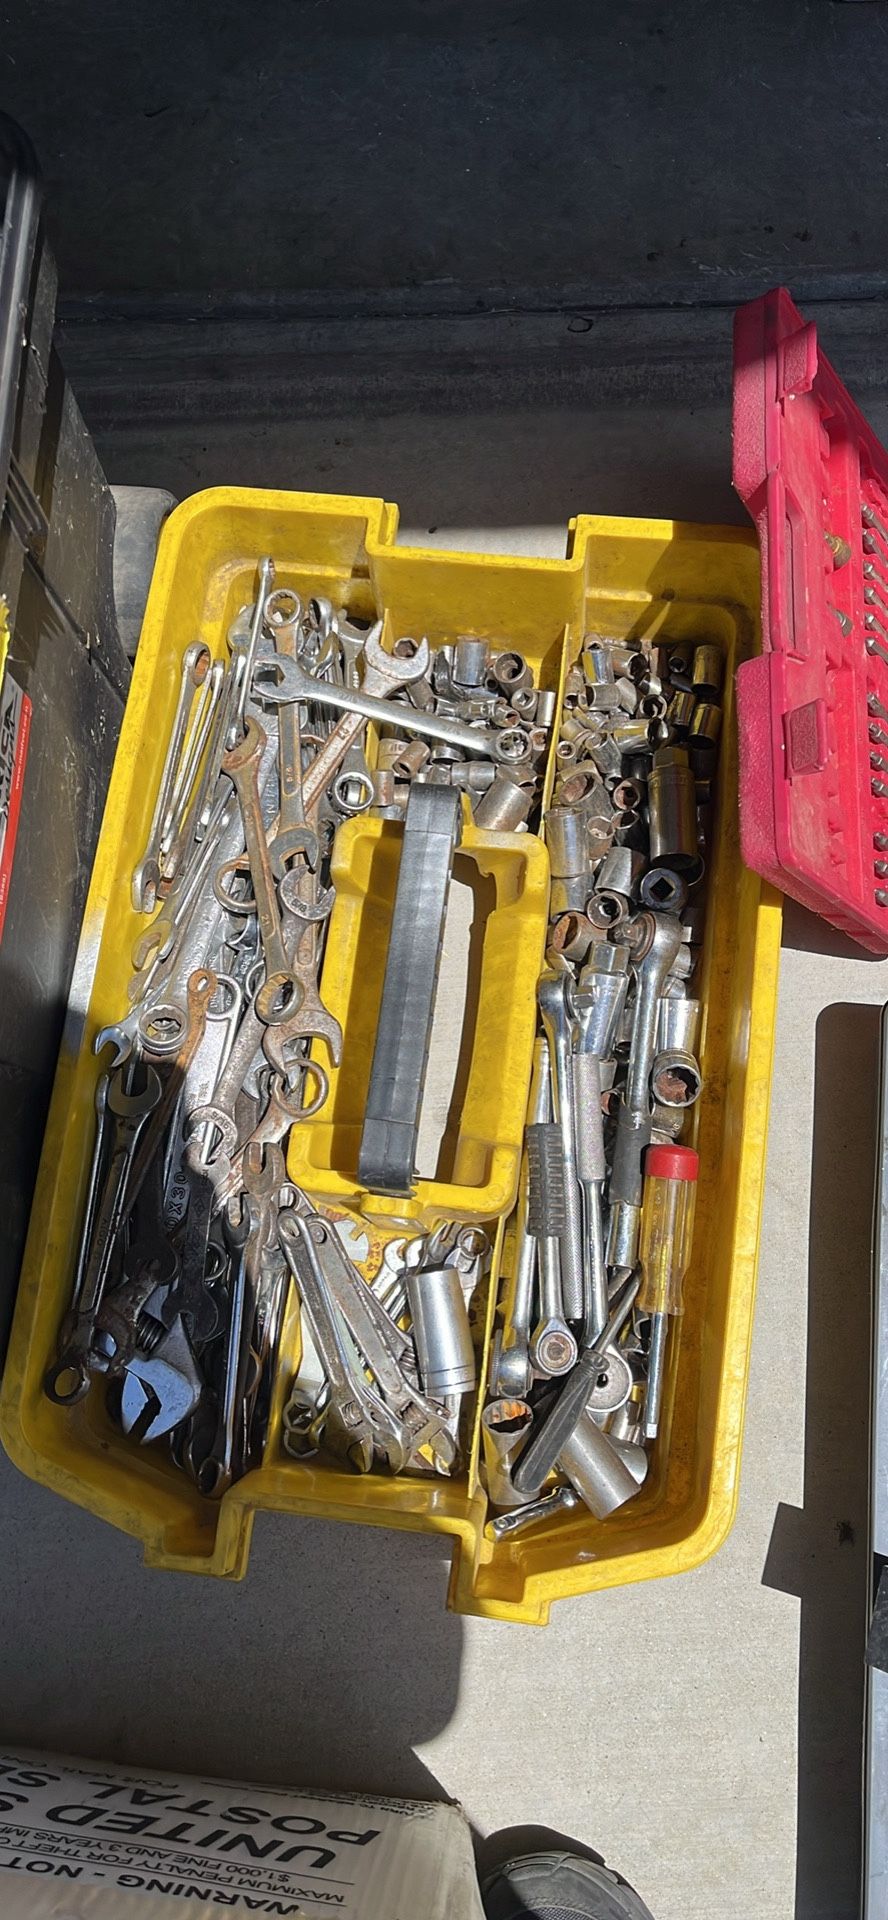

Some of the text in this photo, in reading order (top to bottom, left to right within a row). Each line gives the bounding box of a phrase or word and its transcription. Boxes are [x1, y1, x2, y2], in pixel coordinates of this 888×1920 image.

[88, 1780, 382, 1846] POSTAL
[32, 1831, 107, 1850] YEARS
[45, 1804, 336, 1869] UNITED
[15, 1838, 82, 1857] THEFT
[108, 1843, 122, 1851] 3
[121, 1847, 168, 1860] AND
[0, 1856, 84, 1878] NOT
[86, 1851, 134, 1866] FOR
[172, 1854, 222, 1871] FINE
[135, 1859, 234, 1884] PENALTY
[116, 1874, 299, 1915] WARNING
[239, 1877, 345, 1903] MAXIMUM
